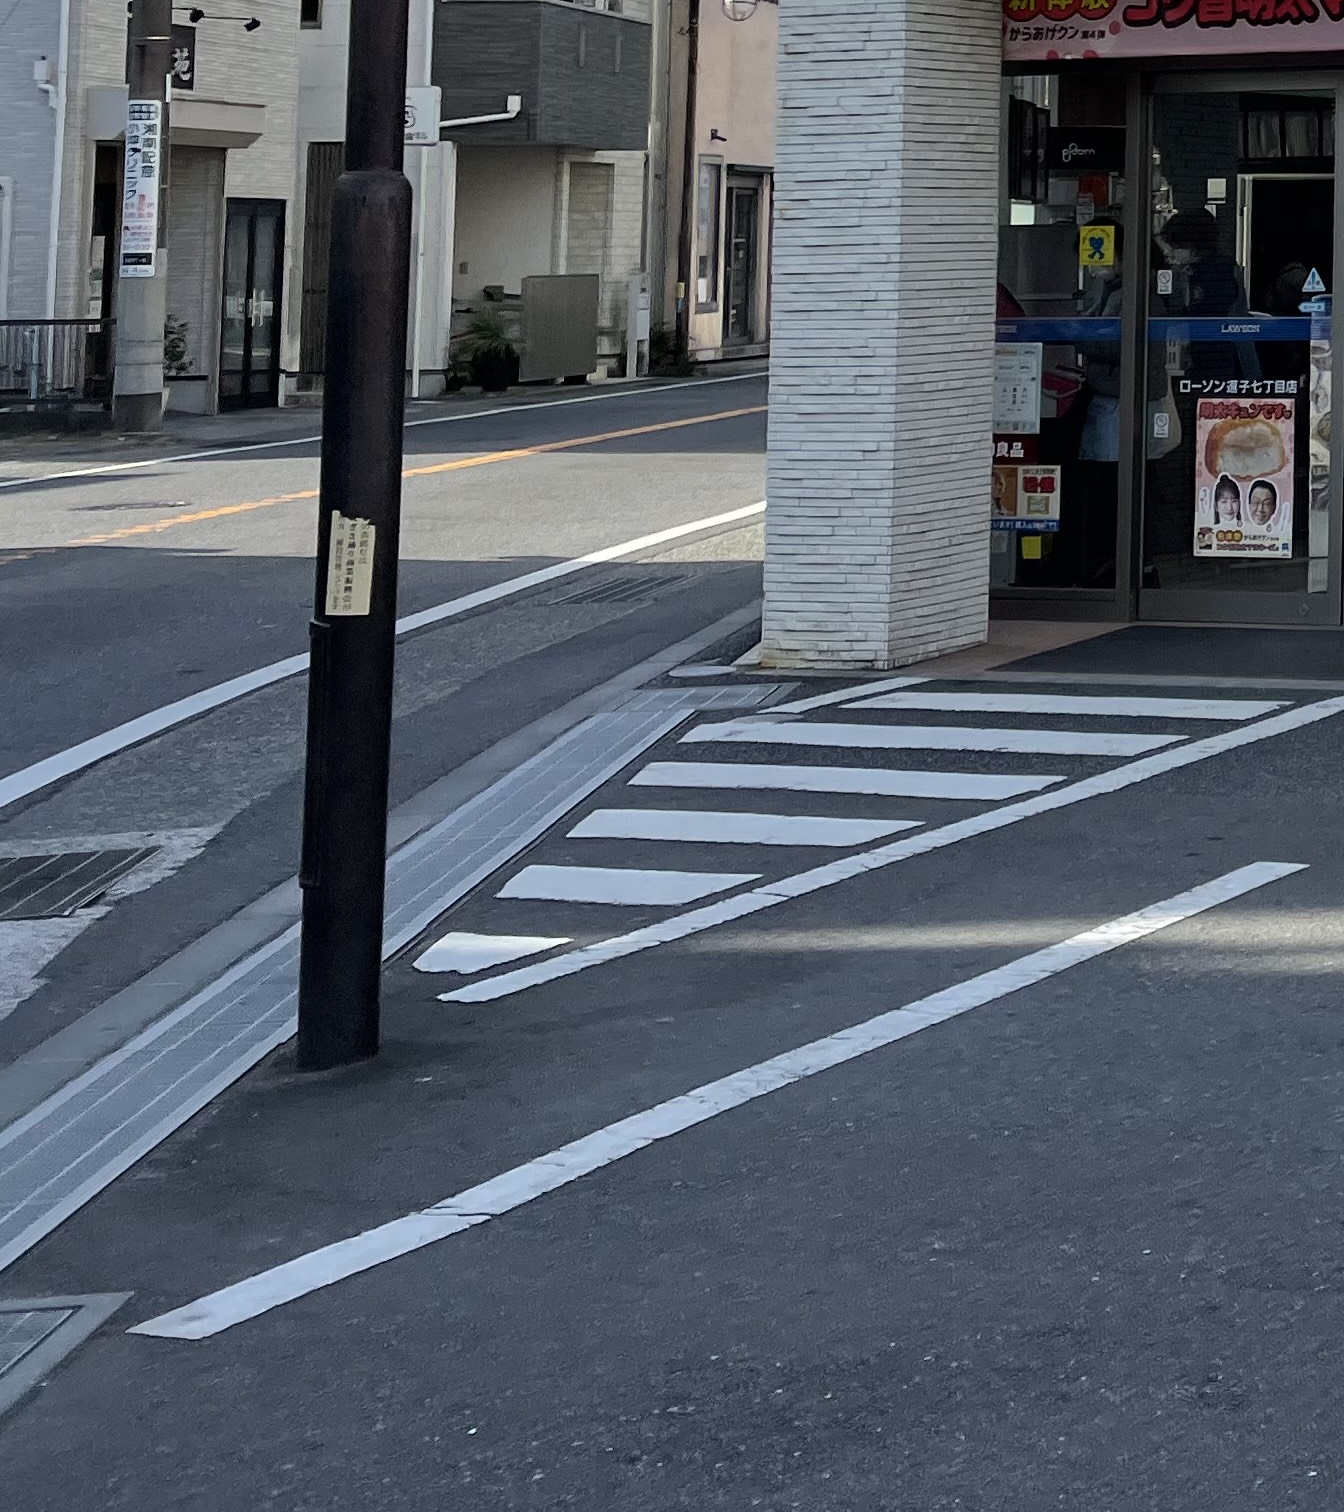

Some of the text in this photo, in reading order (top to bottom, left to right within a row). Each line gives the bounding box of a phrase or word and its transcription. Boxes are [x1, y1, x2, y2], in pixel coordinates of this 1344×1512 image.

[1008, 25, 1079, 42] からあげクン
[1221, 324, 1260, 333] LAWSON
[1179, 379, 1298, 393] ローソン逗子七丁目店
[992, 441, 1024, 458] 良品
